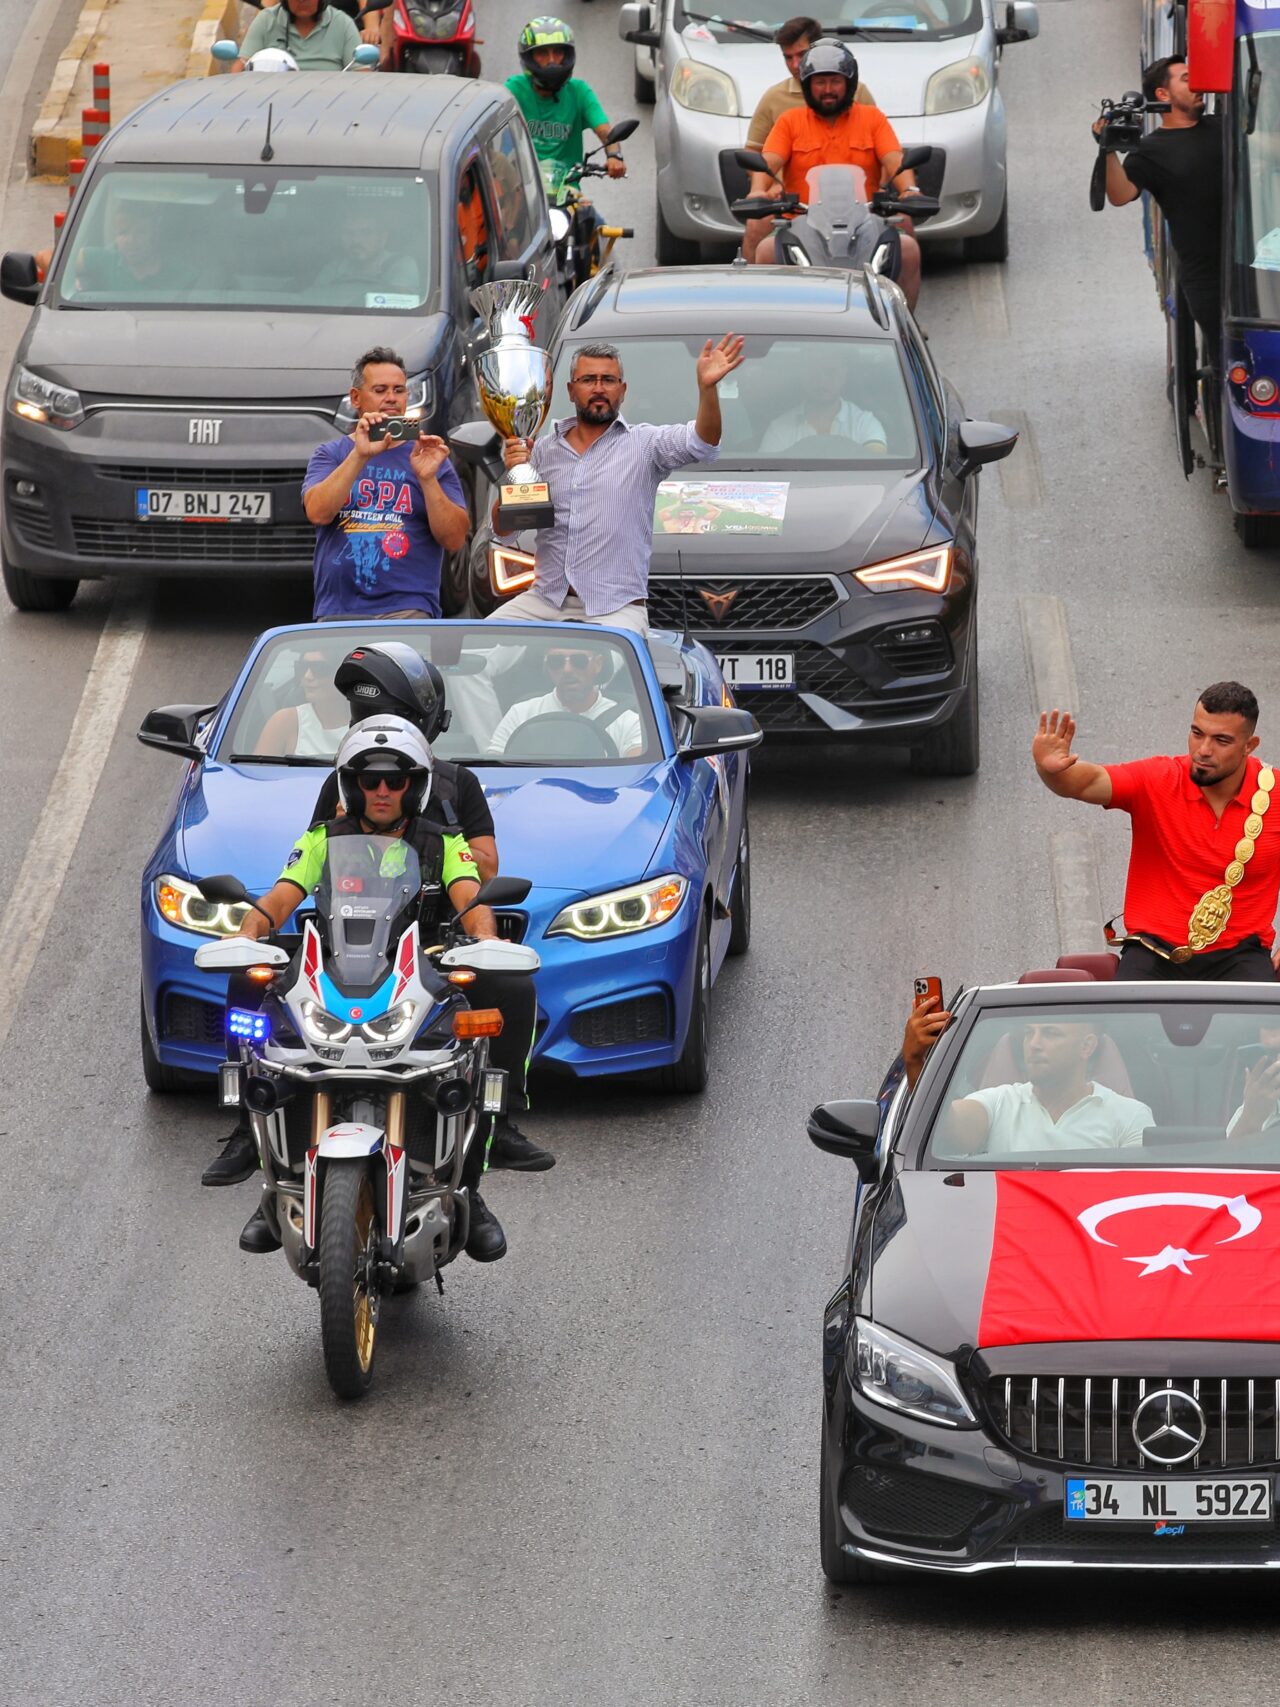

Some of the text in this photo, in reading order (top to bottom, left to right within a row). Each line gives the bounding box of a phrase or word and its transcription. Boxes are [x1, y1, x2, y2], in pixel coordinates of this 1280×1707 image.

[188, 419, 223, 444] FIAT
[366, 465, 407, 480] TEAM
[149, 492, 265, 515] 07 BNJ 247
[351, 510, 383, 521] SIXTEEN
[384, 513, 403, 522] GOAL
[756, 658, 787, 681] 118
[356, 685, 377, 696] SHOEI
[1070, 1501, 1083, 1510] TR
[1085, 1484, 1267, 1516] 34 NL 5922
